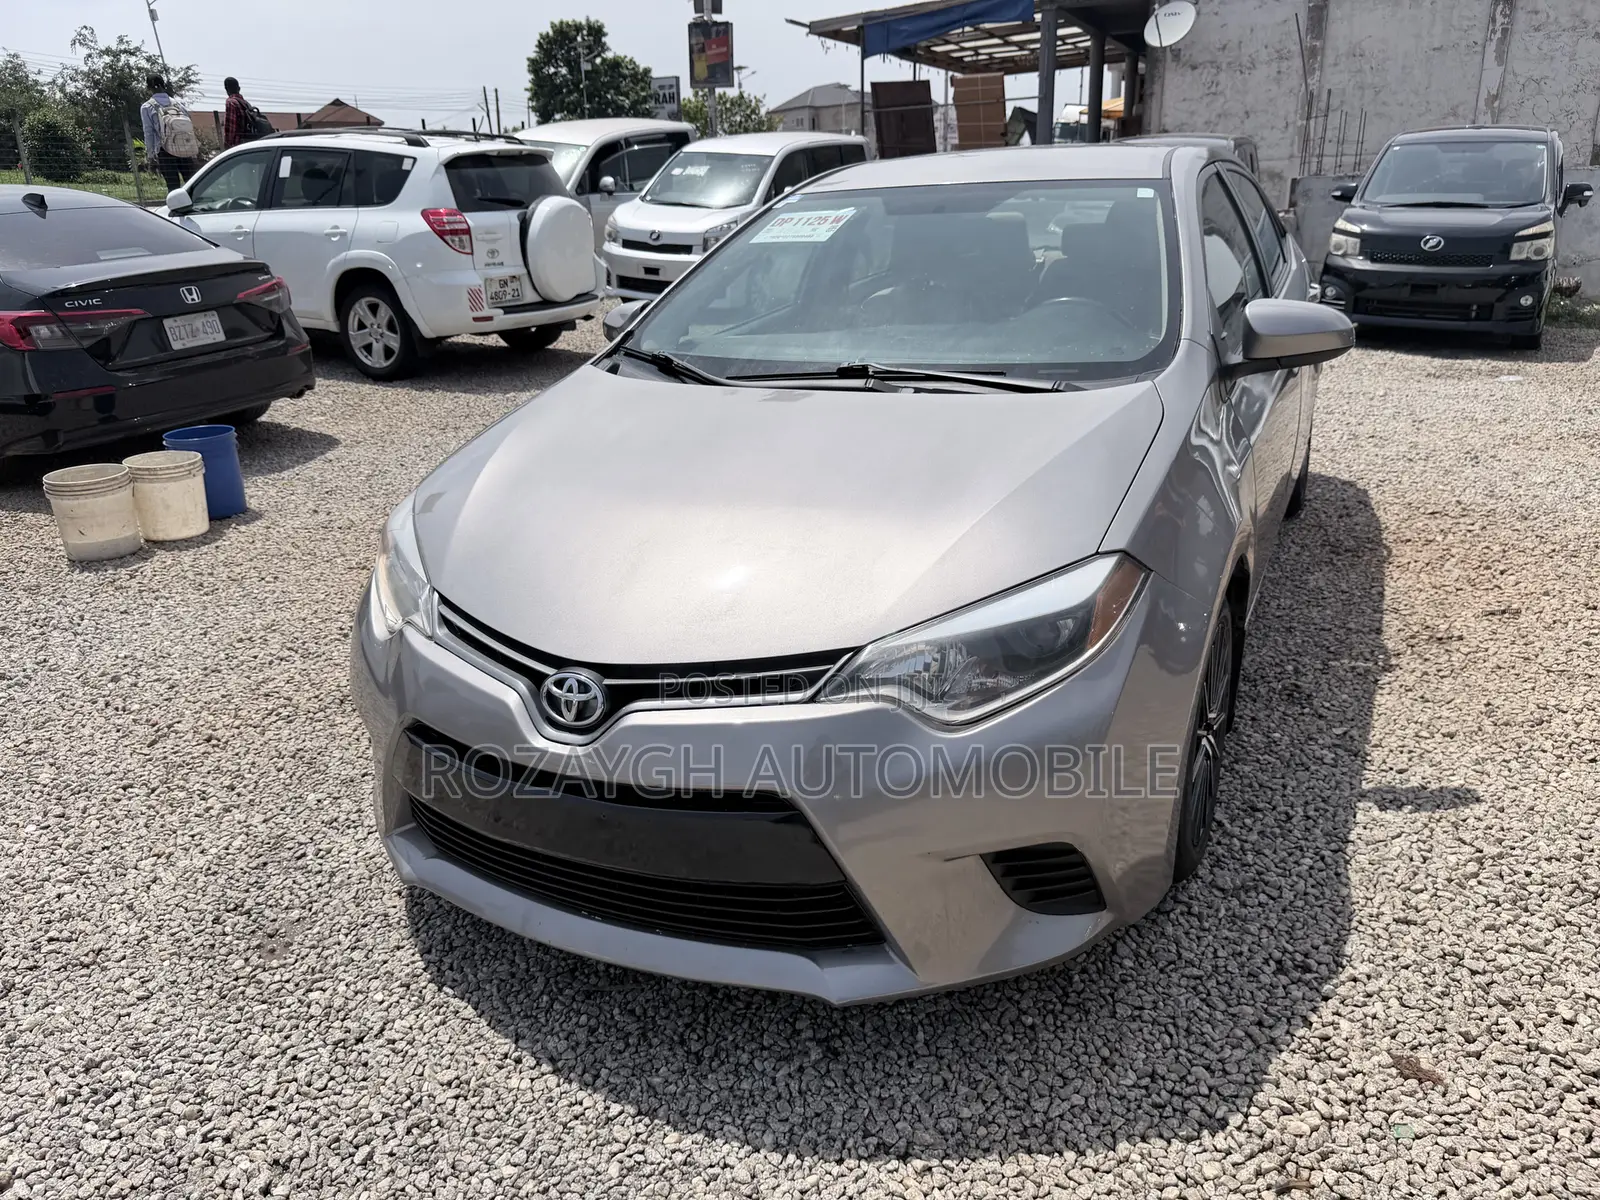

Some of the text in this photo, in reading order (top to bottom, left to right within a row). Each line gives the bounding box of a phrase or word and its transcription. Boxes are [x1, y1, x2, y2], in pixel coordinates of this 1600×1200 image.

[770, 213, 849, 228] DP 1125 W
[64, 298, 103, 308] CIVIC
[201, 319, 222, 336] 490
